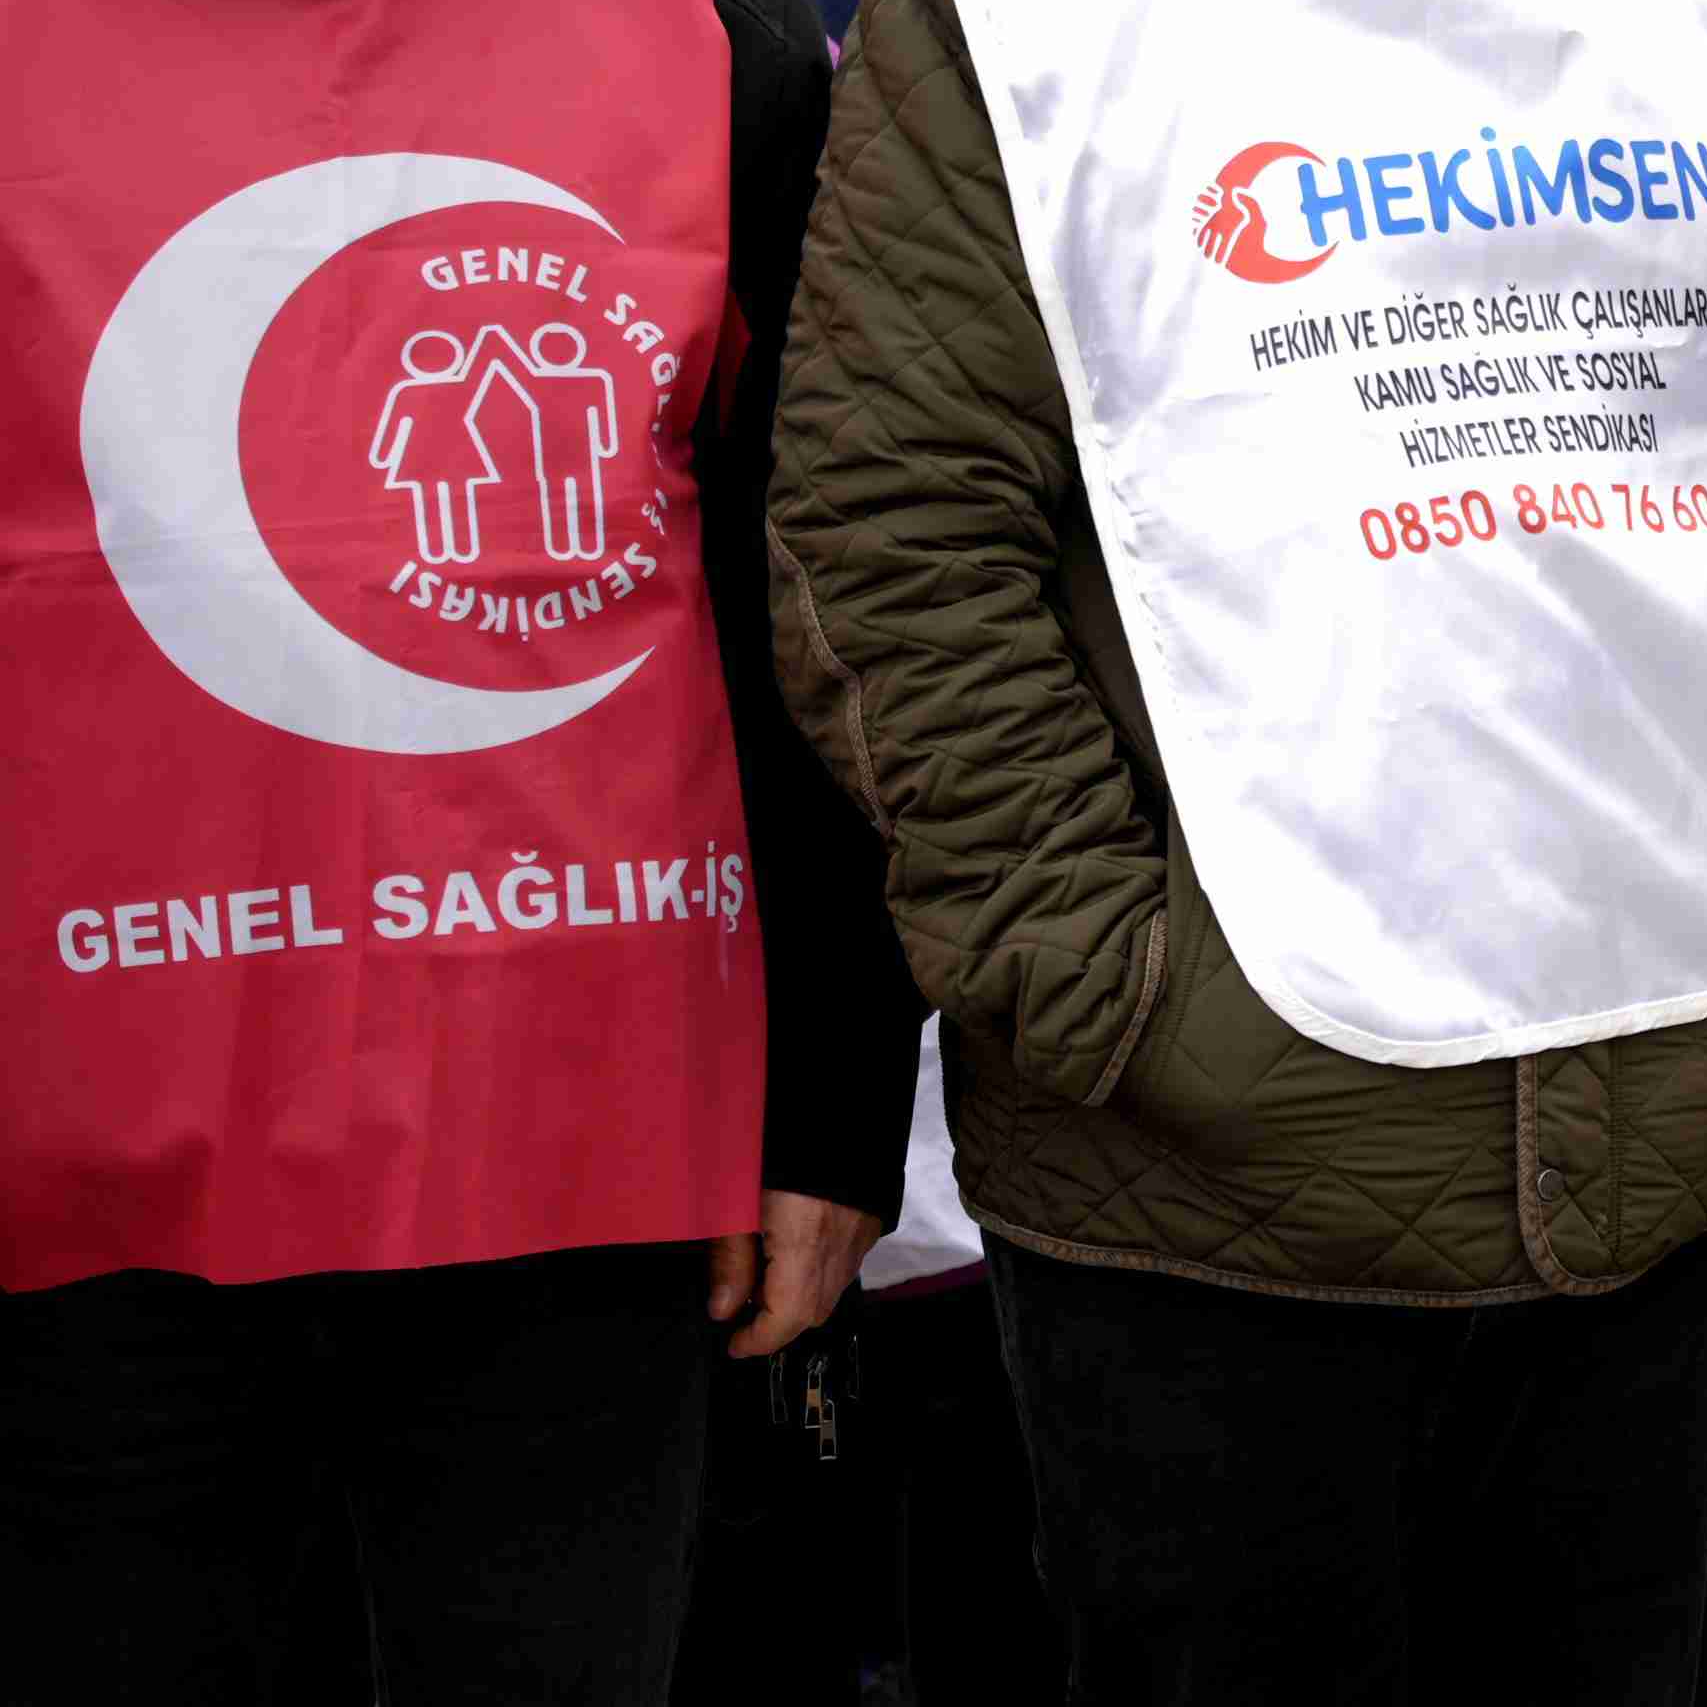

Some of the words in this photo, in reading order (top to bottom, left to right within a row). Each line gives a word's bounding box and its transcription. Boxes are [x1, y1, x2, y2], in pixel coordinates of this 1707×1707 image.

[421, 246, 588, 303] GENEL
[1250, 309, 1338, 371] HEKİM
[1341, 310, 1378, 351] VE
[1384, 292, 1469, 345] DİĞER
[1473, 282, 1567, 336] SAĞLIK
[1354, 366, 1437, 412] KAMU
[1440, 351, 1540, 401] SAĞLIK
[1536, 354, 1575, 392] VE
[1576, 351, 1667, 392] SOSYAL
[1399, 418, 1542, 468] HİZMETLER
[1543, 403, 1659, 453] SENDİKASI
[1360, 489, 1496, 561] 0850
[1513, 482, 1605, 534] 840
[389, 542, 657, 642] SENDİKASI
[57, 884, 343, 973] GENEL
[371, 841, 744, 932] SAĞLIK-İŞ
